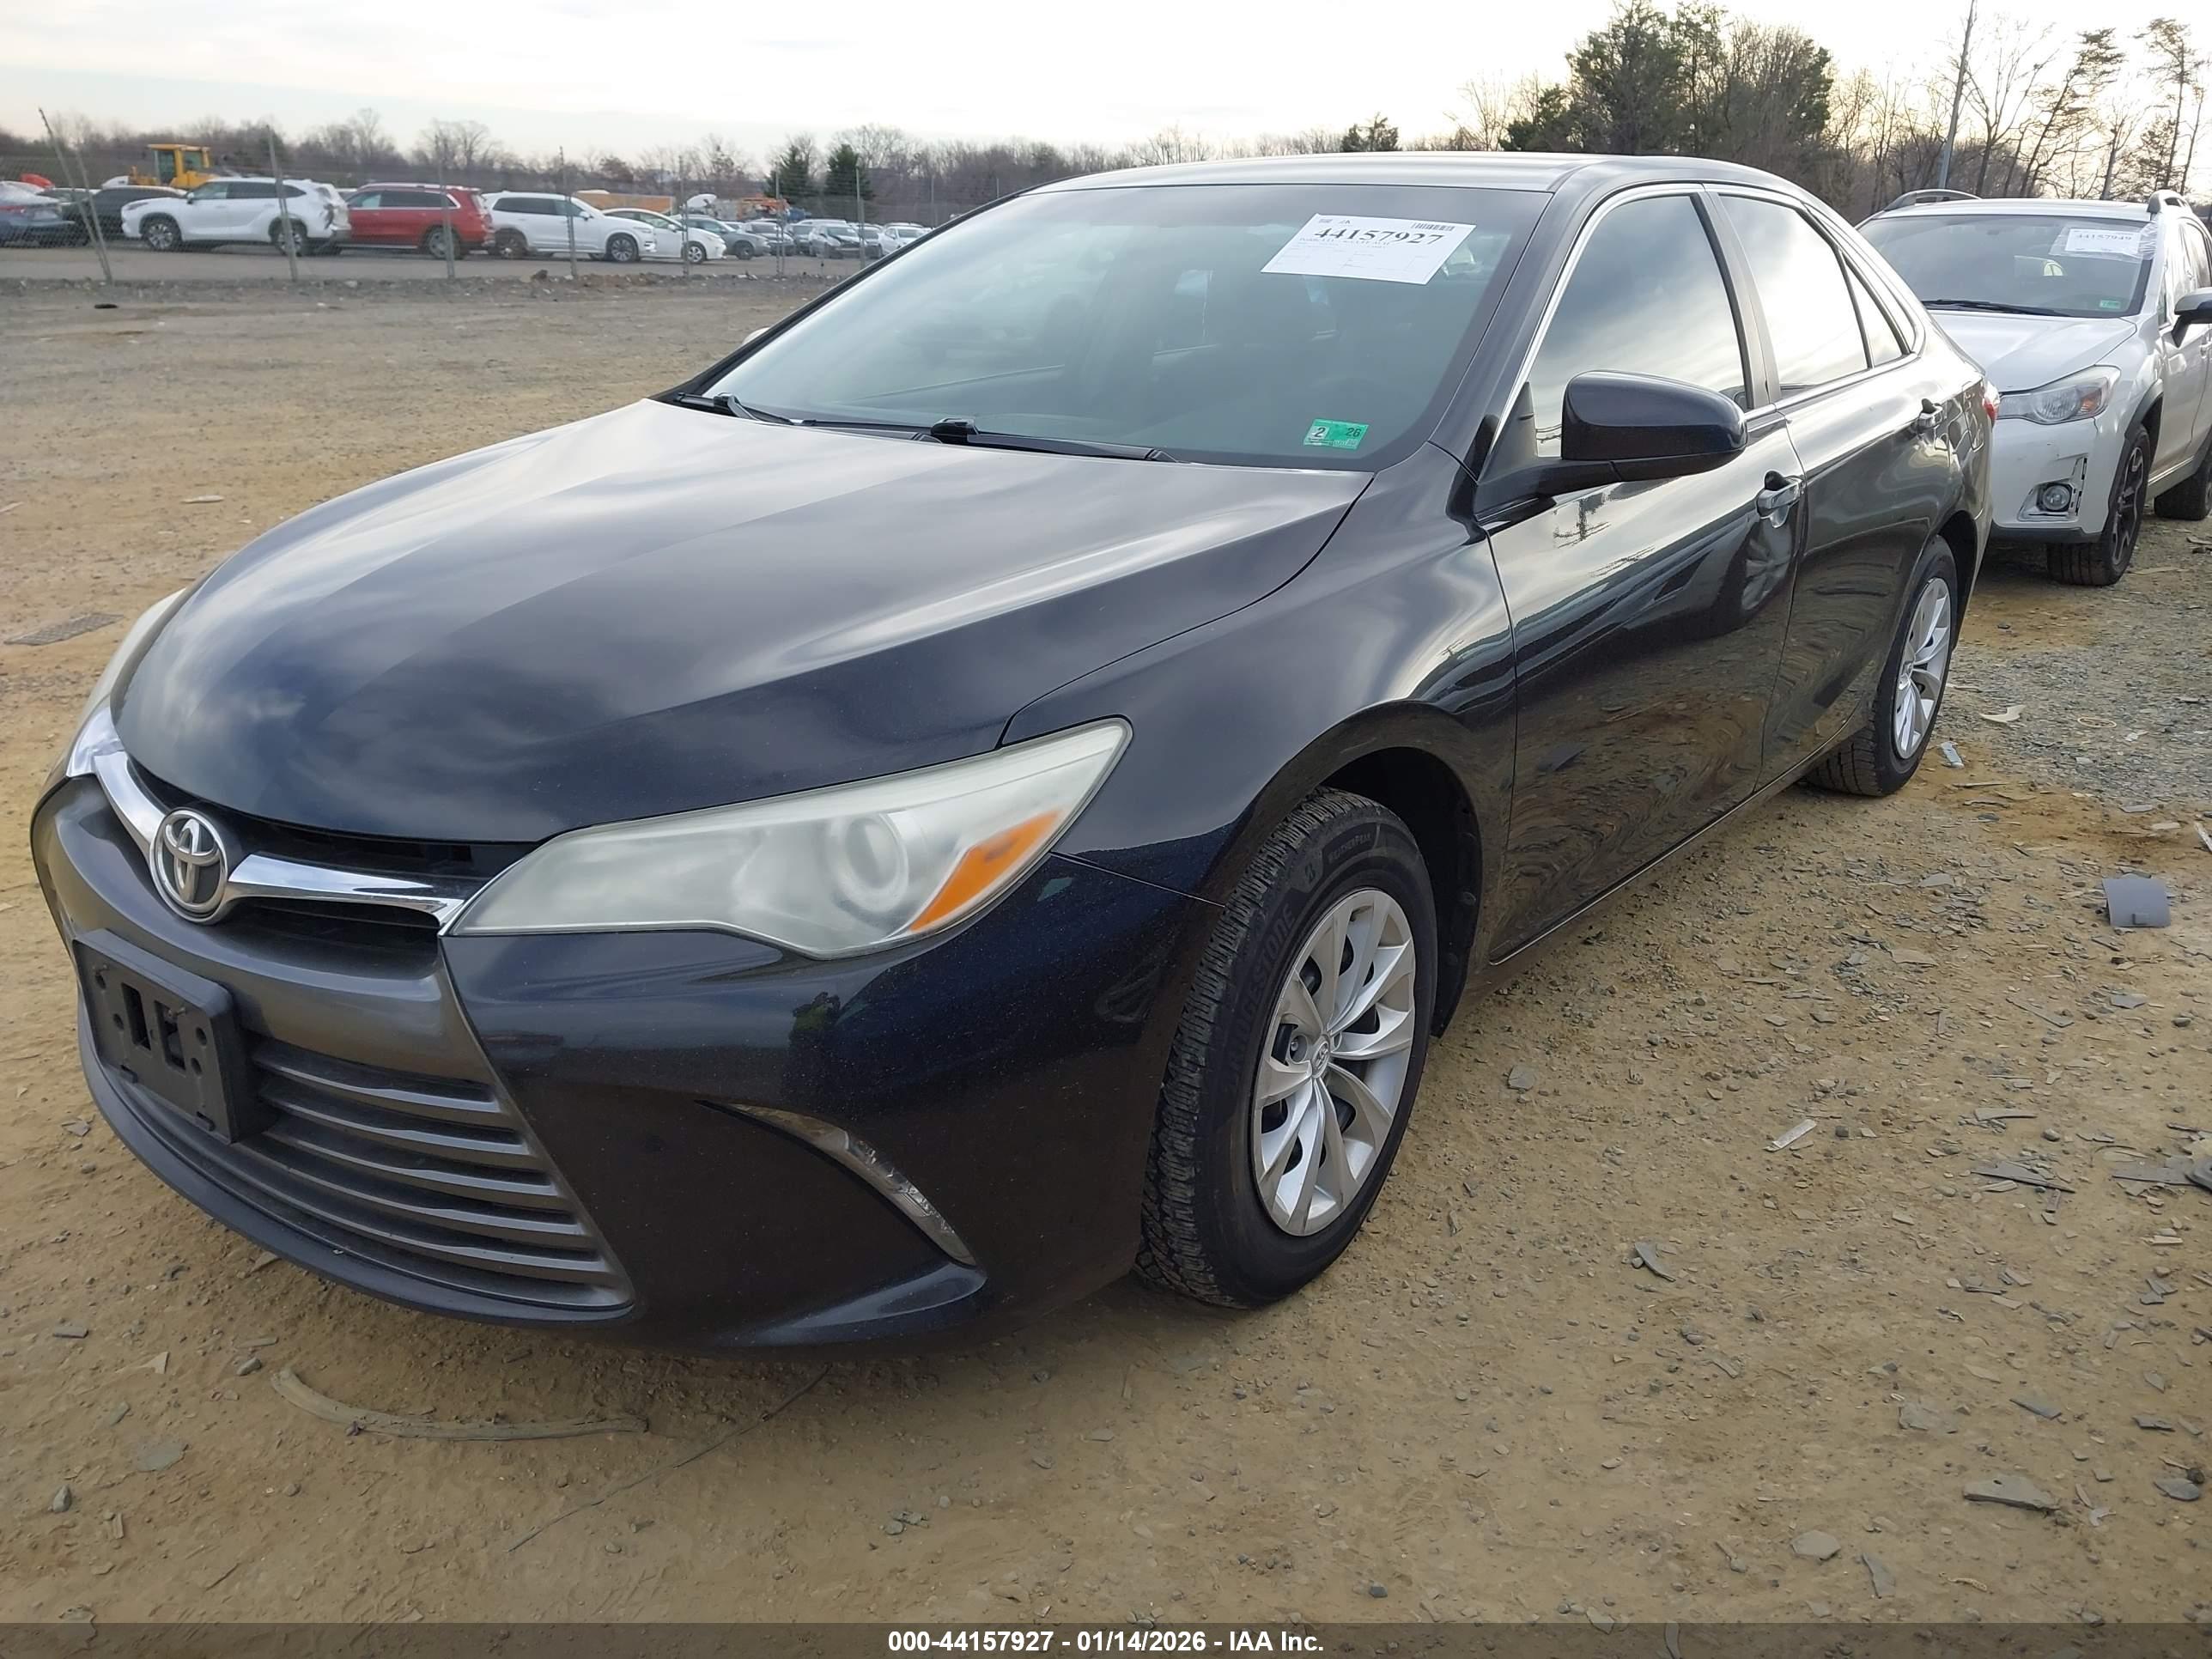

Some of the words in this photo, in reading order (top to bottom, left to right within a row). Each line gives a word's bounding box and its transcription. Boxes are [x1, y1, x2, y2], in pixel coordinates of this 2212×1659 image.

[1314, 226, 1444, 245] 44157927
[1314, 427, 1326, 437] 2
[1346, 428, 1361, 437] 26
